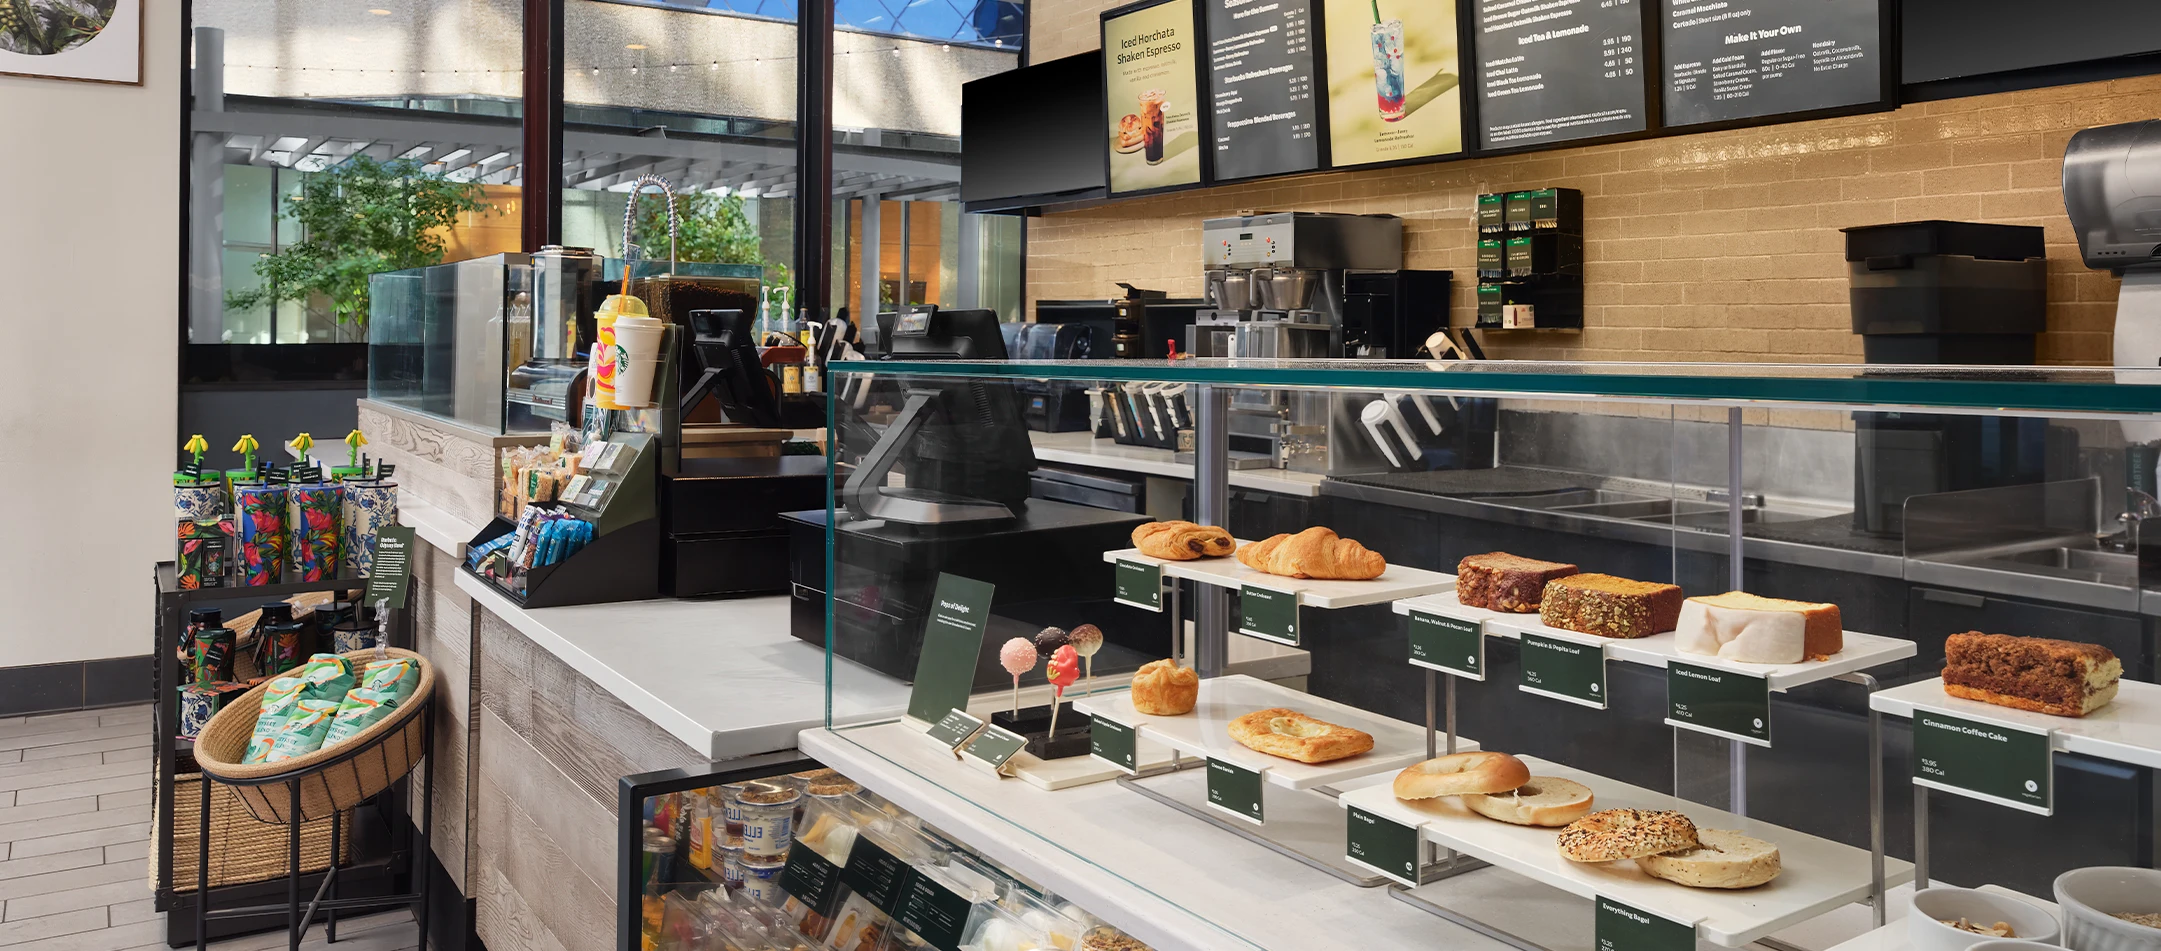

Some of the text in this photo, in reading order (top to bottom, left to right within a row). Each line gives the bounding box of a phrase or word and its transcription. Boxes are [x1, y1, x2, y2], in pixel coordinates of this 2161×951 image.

[1672, 2, 1728, 17] Caramel Macchiato
[1673, 19, 1696, 29] Cortado
[1698, 15, 1712, 24] Short
[1740, 9, 1752, 17] only
[1121, 28, 1175, 49] Iced Horchata
[1518, 24, 1590, 45] Iced Tea & Lemonade
[1725, 24, 1802, 45] Make It Your Own
[1117, 41, 1181, 65] Shaken Espresso
[1414, 615, 1430, 624] Banana,
[1430, 618, 1446, 627] Walnut
[1450, 623, 1464, 631] Pecan
[1527, 639, 1548, 649] Pumpkin
[1553, 644, 1569, 653] Pepita
[1675, 669, 1721, 683] Iced Lemon Loaf
[1922, 718, 2008, 742] Cinnamon Coffee Cake
[1922, 765, 1945, 776] 380 Cal
[1353, 811, 1375, 824] Plain Bagel
[1602, 902, 1650, 924] Everything Bagel
